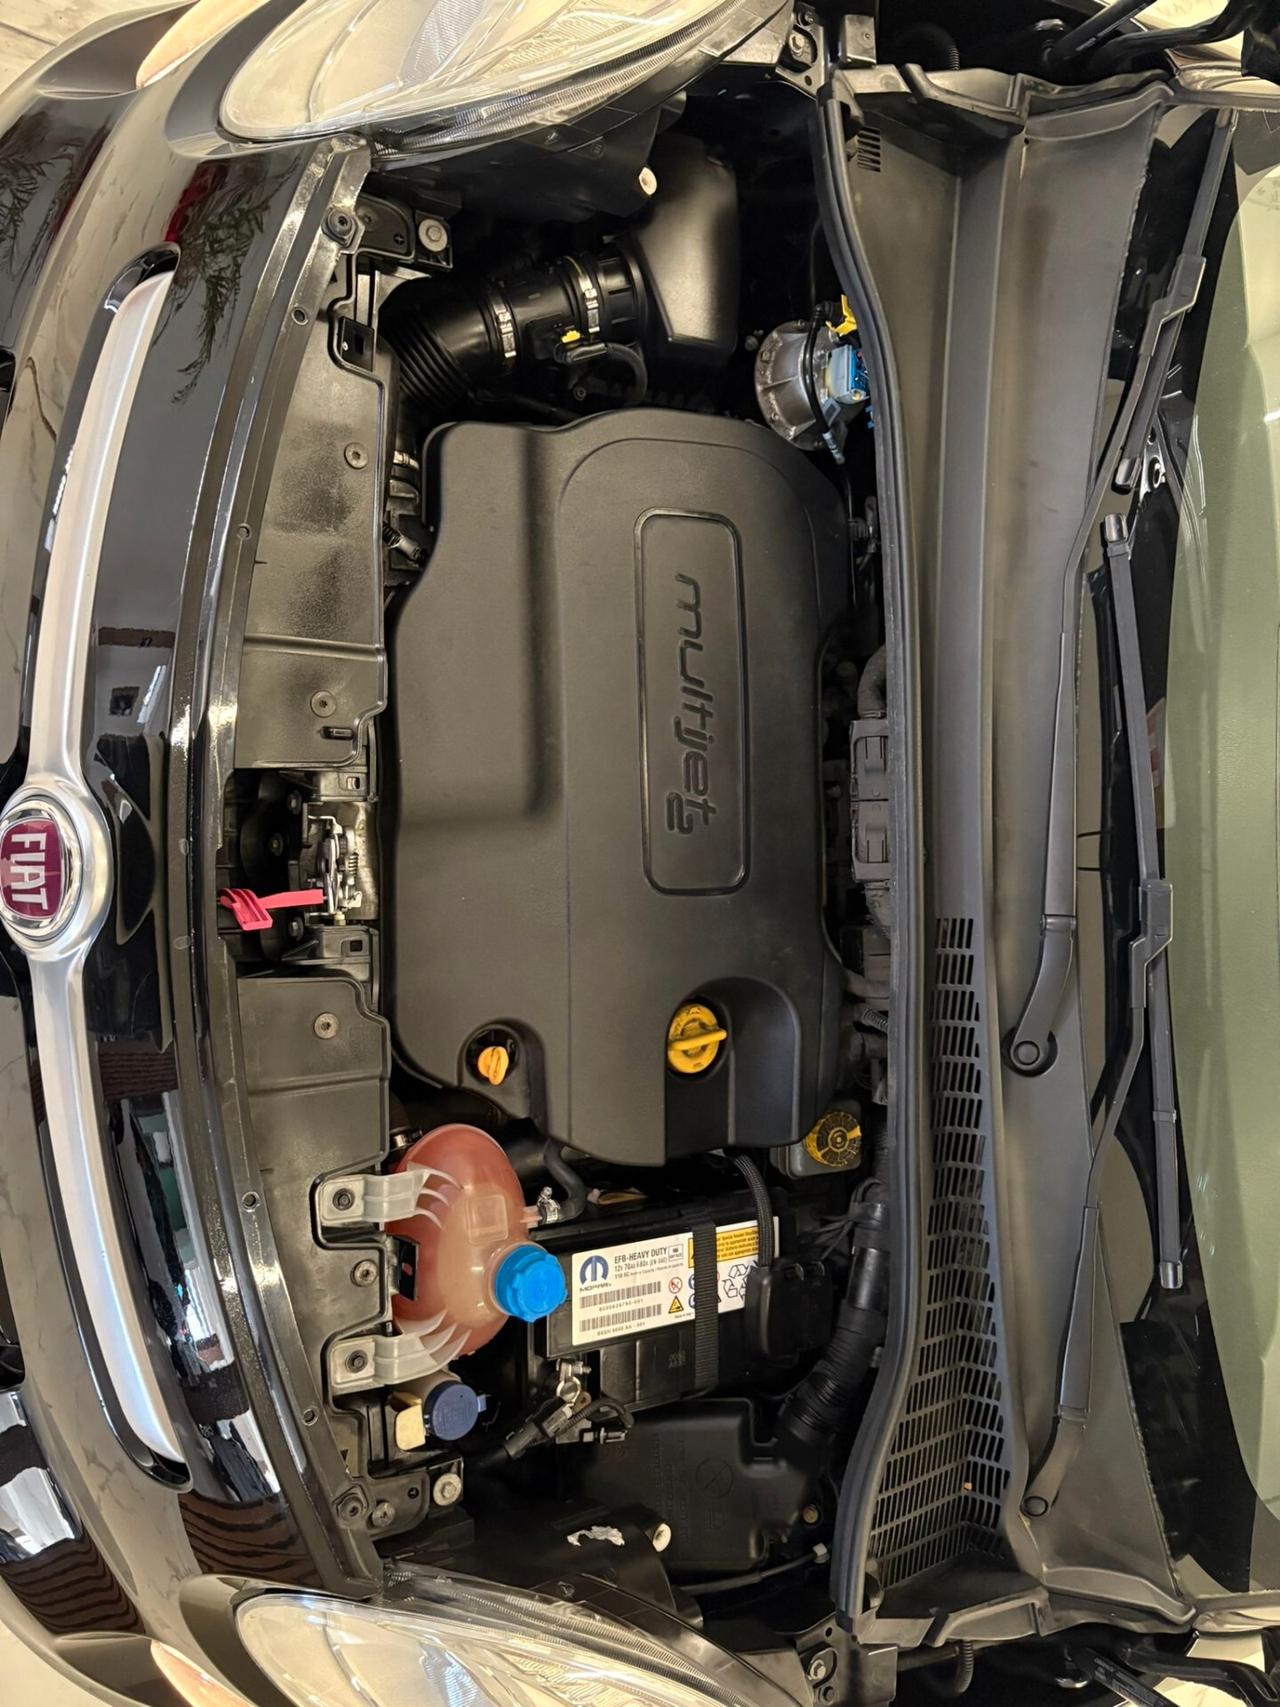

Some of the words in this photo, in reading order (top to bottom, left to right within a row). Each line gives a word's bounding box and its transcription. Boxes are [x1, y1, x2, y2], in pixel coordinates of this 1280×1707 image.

[673, 572, 717, 826] multijet
[10, 832, 48, 910] FIAT
[614, 1249, 650, 1264] EFB-HEAVY
[650, 1246, 668, 1257] DUTY
